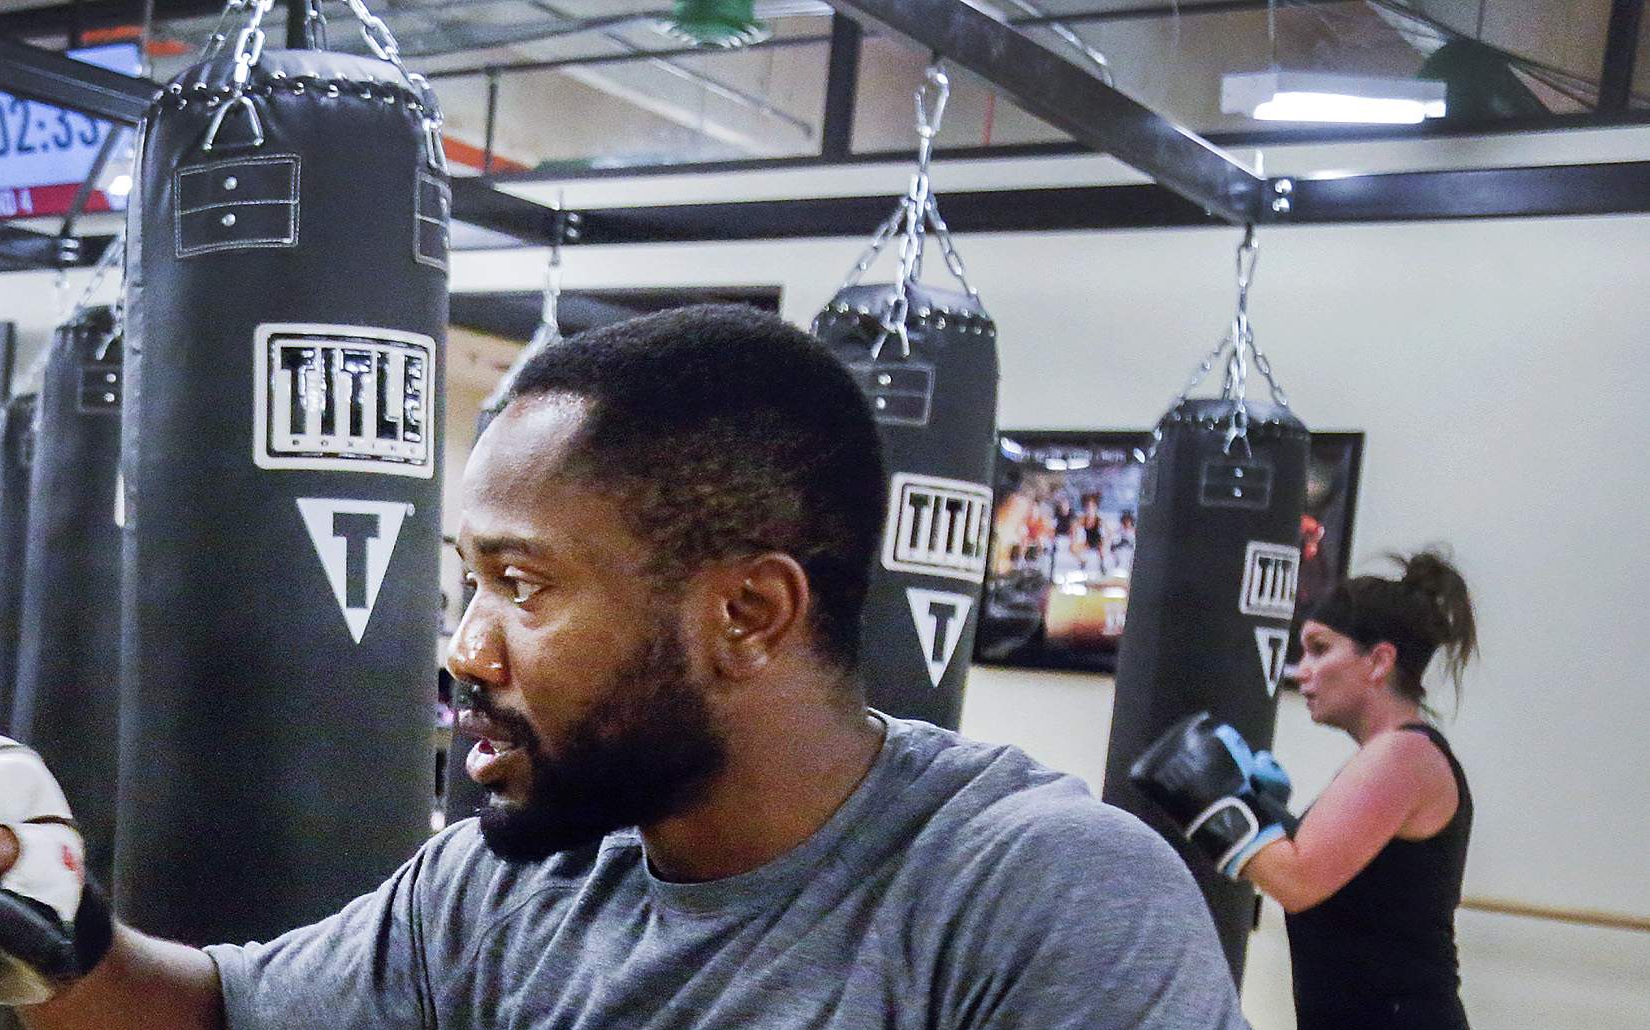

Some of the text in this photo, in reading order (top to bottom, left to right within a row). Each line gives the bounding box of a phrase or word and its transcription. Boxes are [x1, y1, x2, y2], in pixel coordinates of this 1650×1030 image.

[280, 346, 422, 443] TITLE
[908, 492, 985, 558] TITL
[332, 511, 381, 610] T
[1257, 556, 1295, 600] TIT
[928, 601, 958, 663] T
[1268, 636, 1283, 682] T
